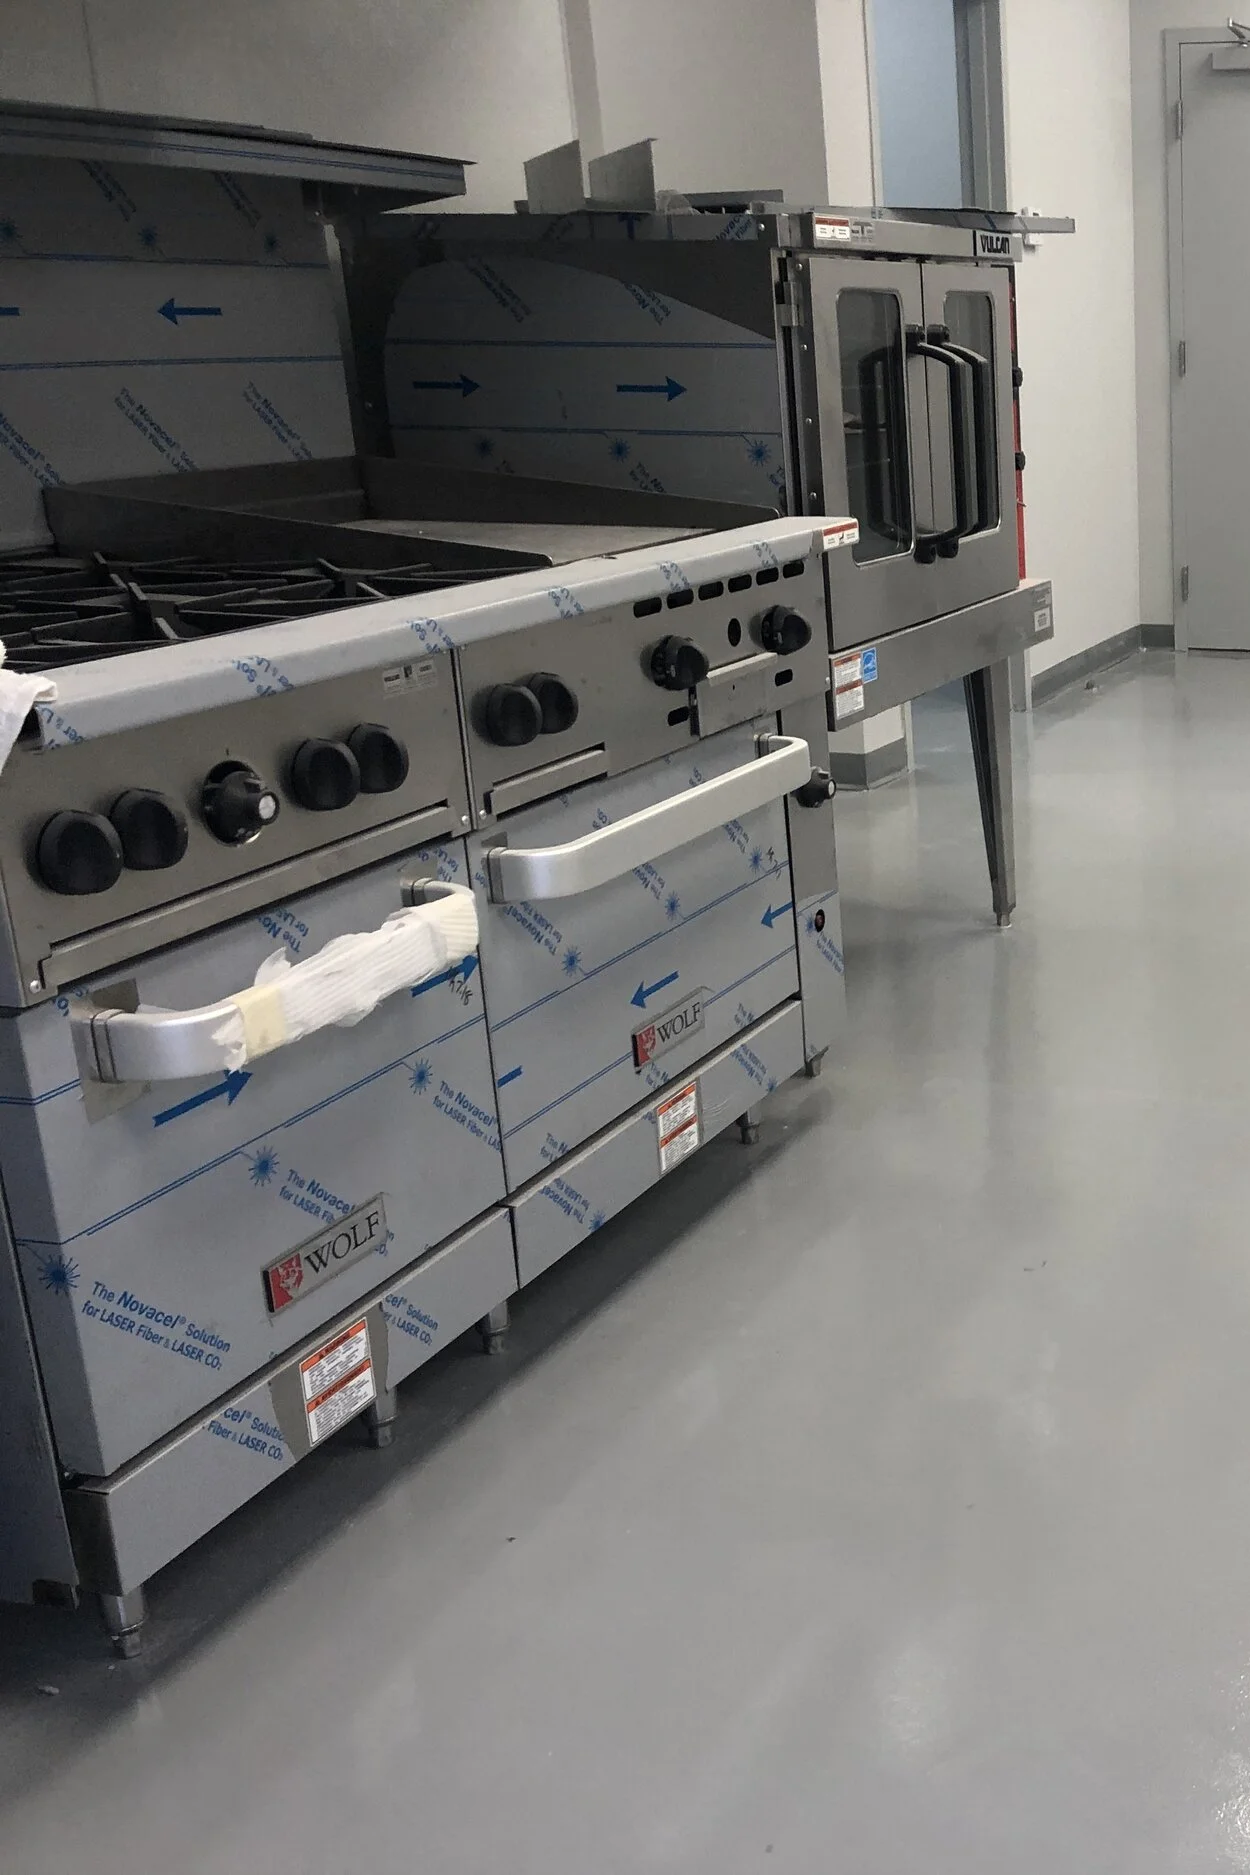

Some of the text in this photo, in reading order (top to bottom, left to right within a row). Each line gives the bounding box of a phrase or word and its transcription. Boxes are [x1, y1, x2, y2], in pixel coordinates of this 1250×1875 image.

[980, 234, 1011, 254] VULCAN
[657, 1001, 701, 1043] WOLF
[287, 1169, 306, 1190] The
[279, 1185, 294, 1202] for
[293, 1193, 320, 1219] LASER
[304, 1210, 380, 1274] WOLF
[82, 1300, 100, 1317] for
[99, 1308, 136, 1334] LASER
[136, 1324, 165, 1345] Fiber
[171, 1338, 204, 1362] LASER
[92, 1281, 115, 1302] The
[185, 1323, 231, 1352] Solution
[396, 1315, 420, 1338] LASER
[207, 1420, 232, 1439] Fiber
[238, 1432, 268, 1455] LASER
